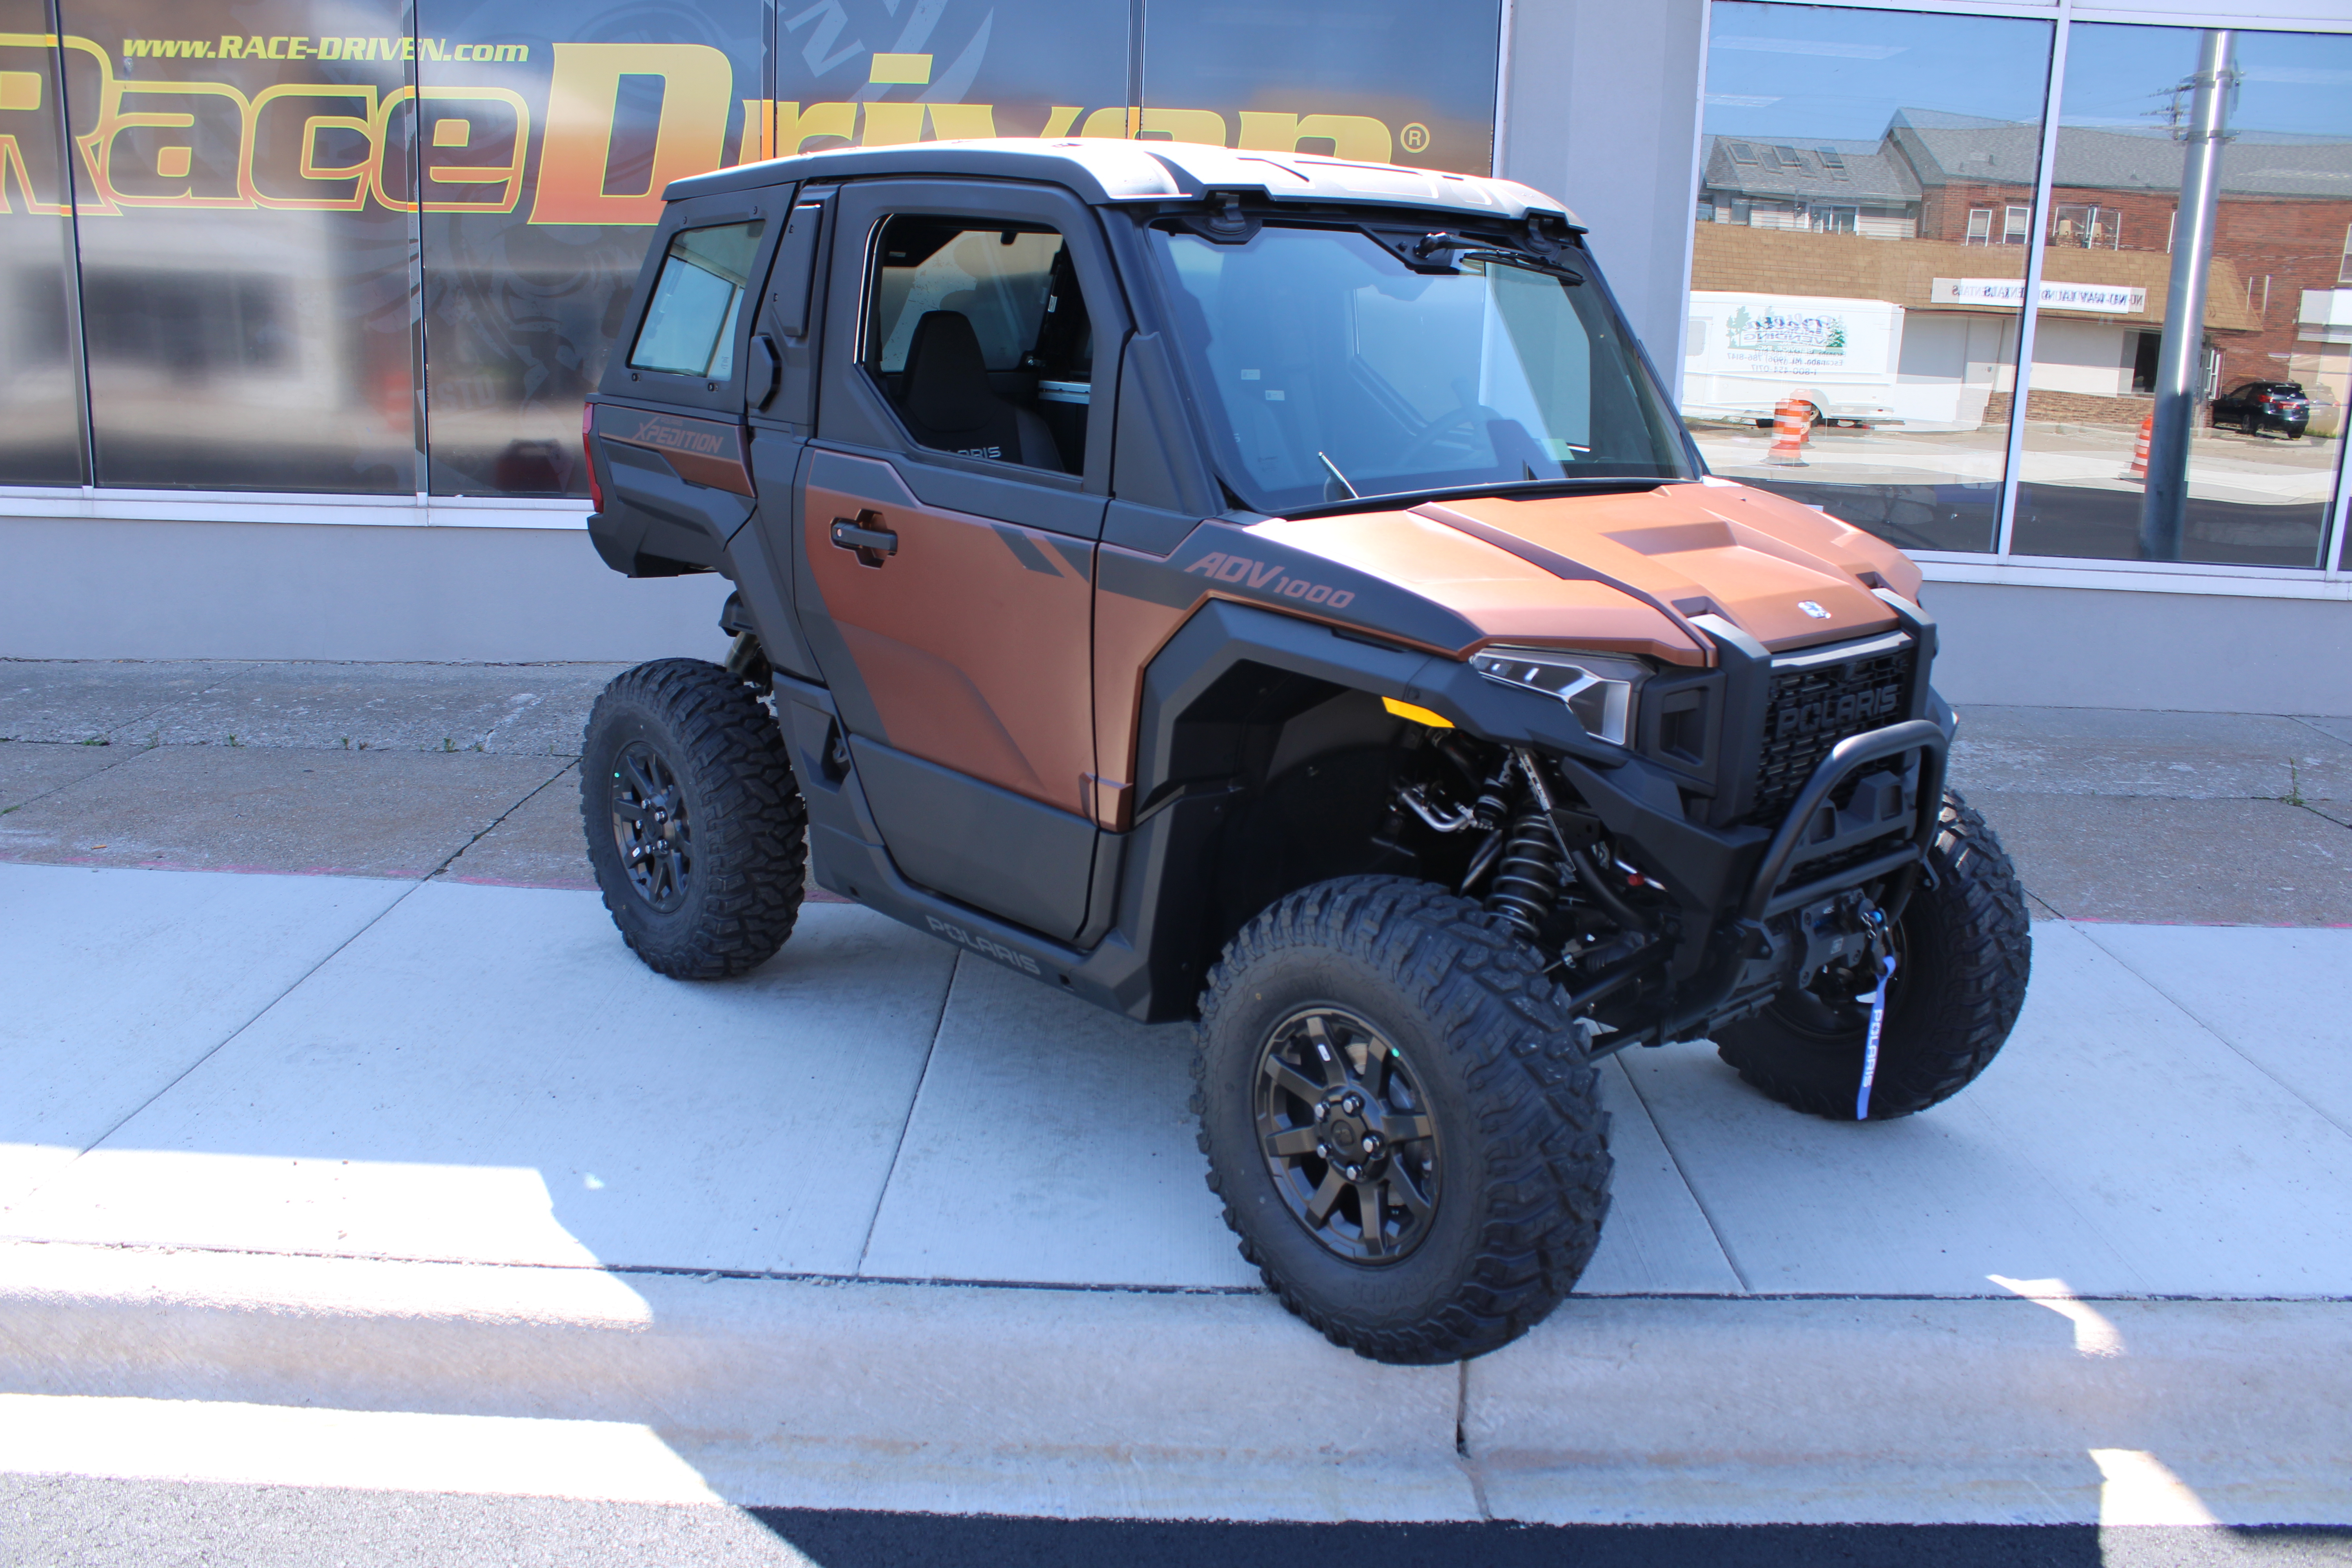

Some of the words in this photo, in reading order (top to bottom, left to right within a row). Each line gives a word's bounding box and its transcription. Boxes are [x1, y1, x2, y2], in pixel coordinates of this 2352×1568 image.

[122, 35, 529, 64] www.RACE-DRIVEN.com
[632, 416, 724, 454] XPEDITION
[1184, 552, 1285, 588] ADV
[1274, 576, 1355, 608] 1000
[1776, 684, 1898, 739] POLARIS
[925, 915, 1041, 975] POLARIS
[1863, 1009, 1883, 1088] POLARIS
